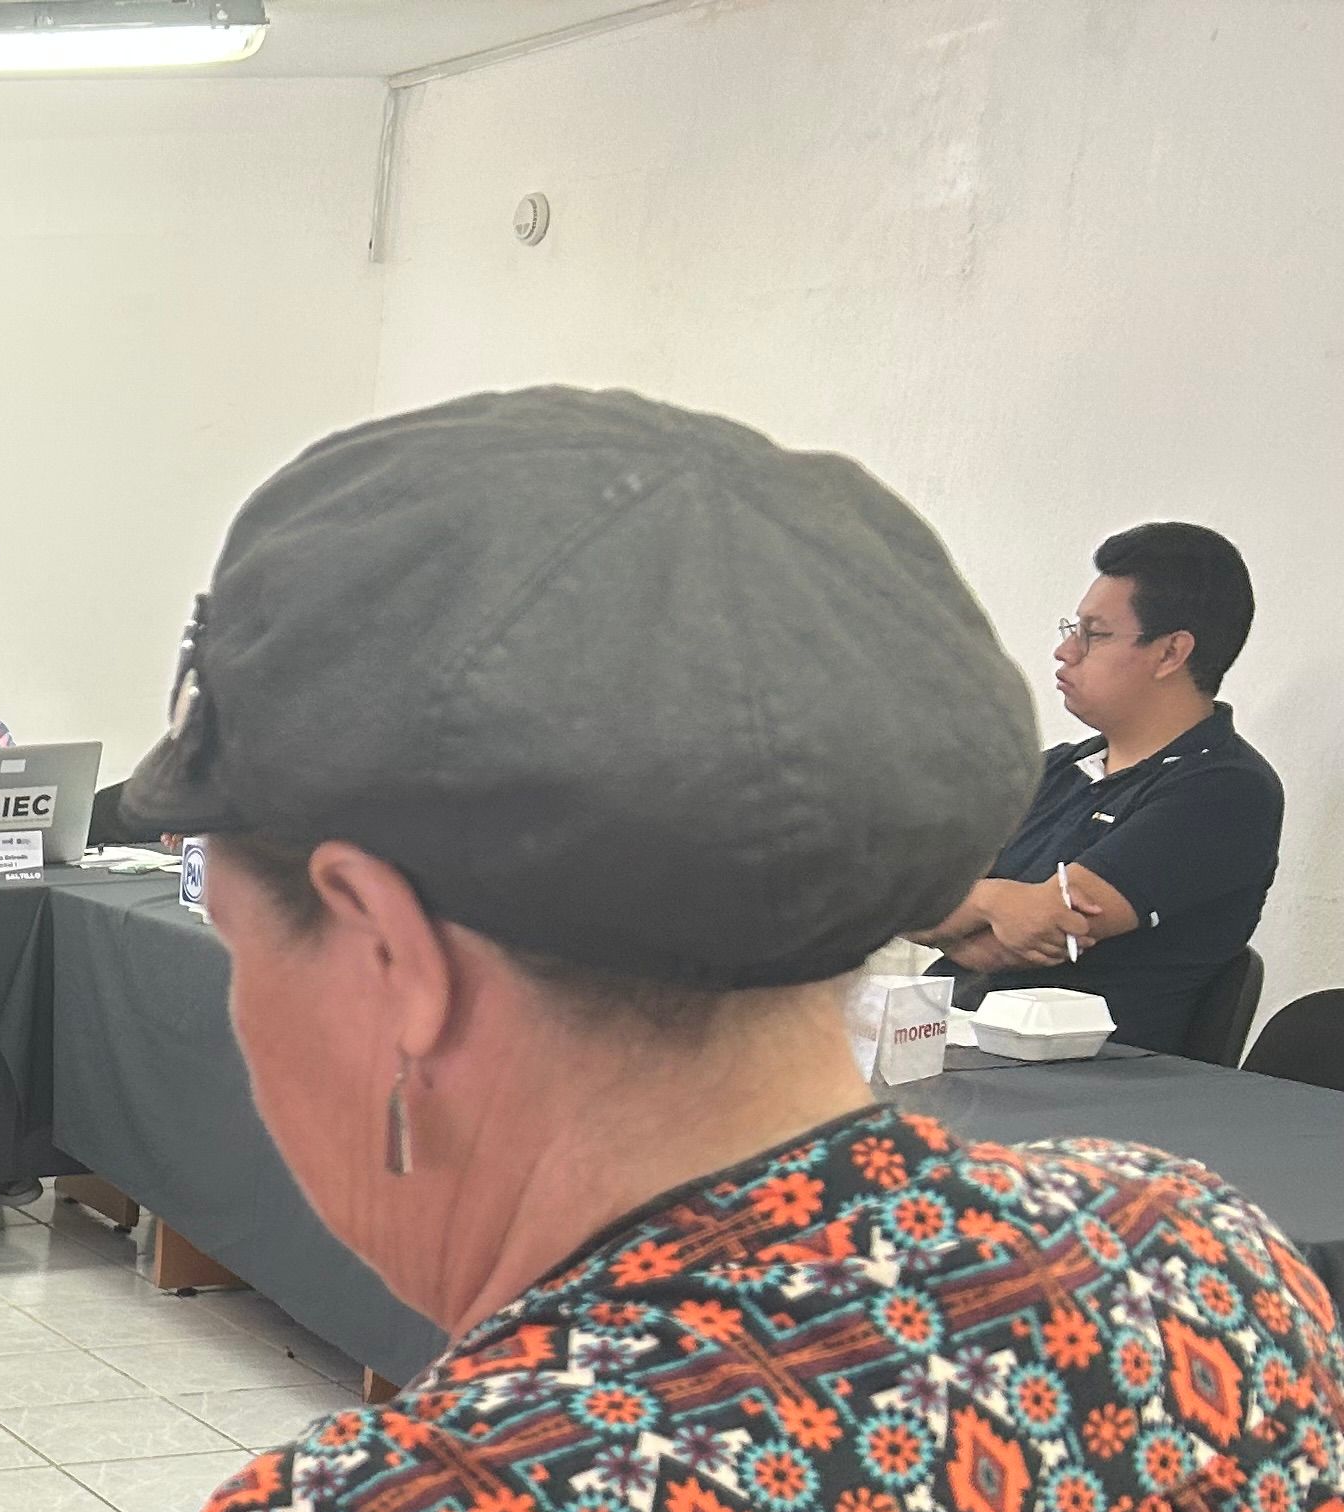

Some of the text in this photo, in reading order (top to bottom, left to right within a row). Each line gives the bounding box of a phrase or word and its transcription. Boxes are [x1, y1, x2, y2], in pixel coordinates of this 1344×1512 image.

[2, 794, 52, 818] IEC
[186, 862, 202, 888] PAN
[894, 1020, 947, 1045] morena
